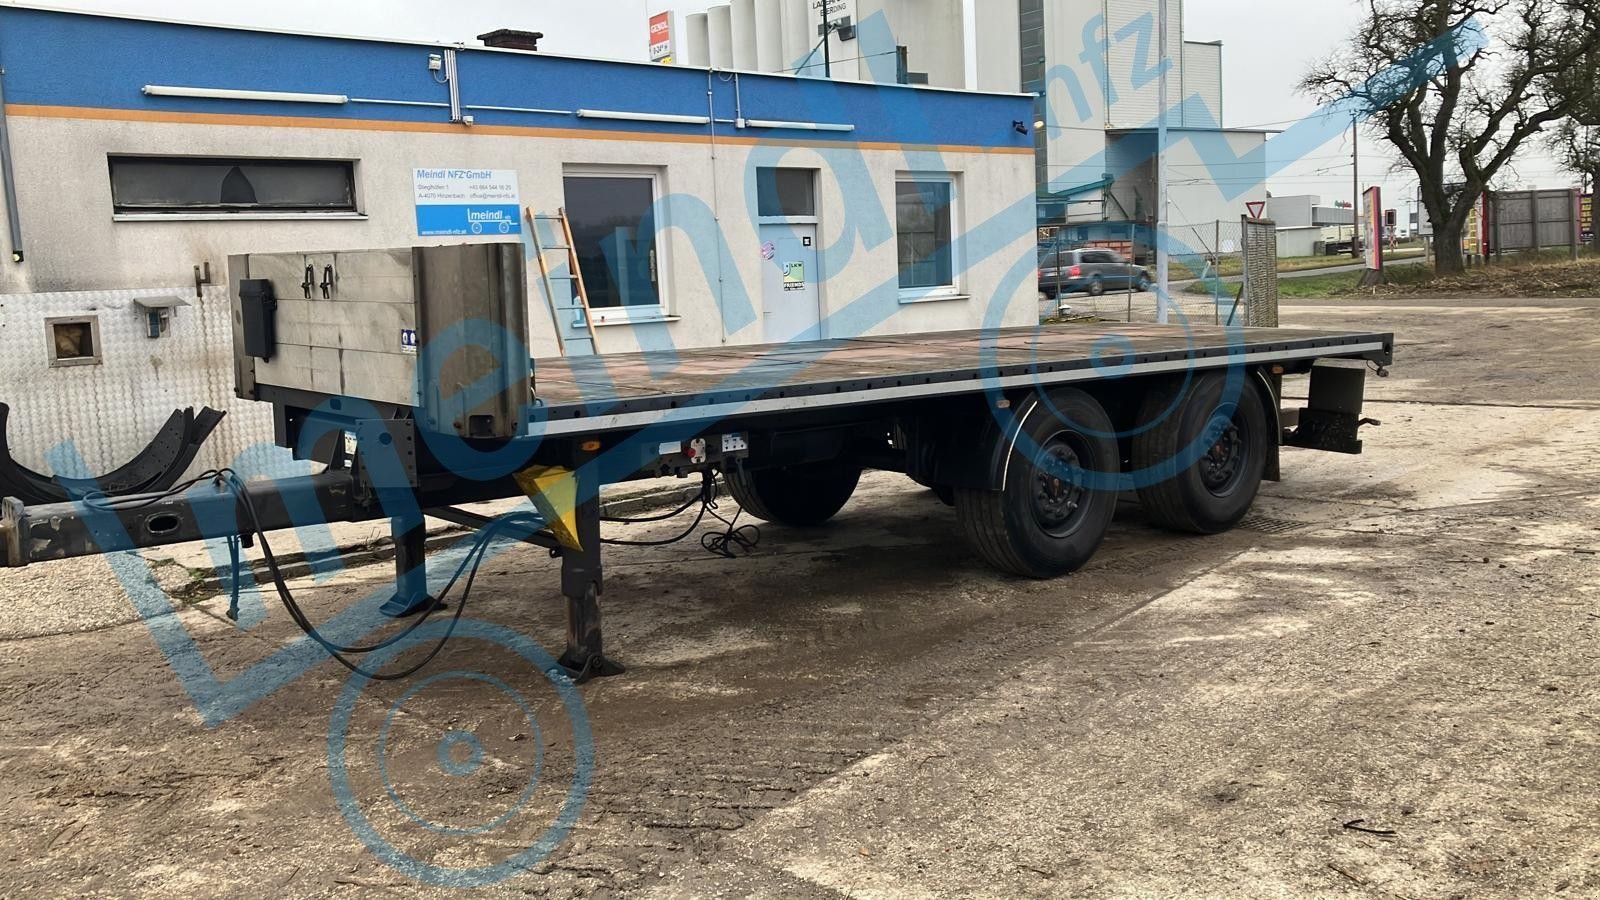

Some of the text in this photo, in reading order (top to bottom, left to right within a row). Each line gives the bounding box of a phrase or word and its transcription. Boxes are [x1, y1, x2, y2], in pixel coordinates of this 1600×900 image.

[820, 3, 847, 16] EERDING
[416, 169, 446, 179] Meindl
[465, 170, 492, 179] GmbH
[471, 210, 503, 220] meindl
